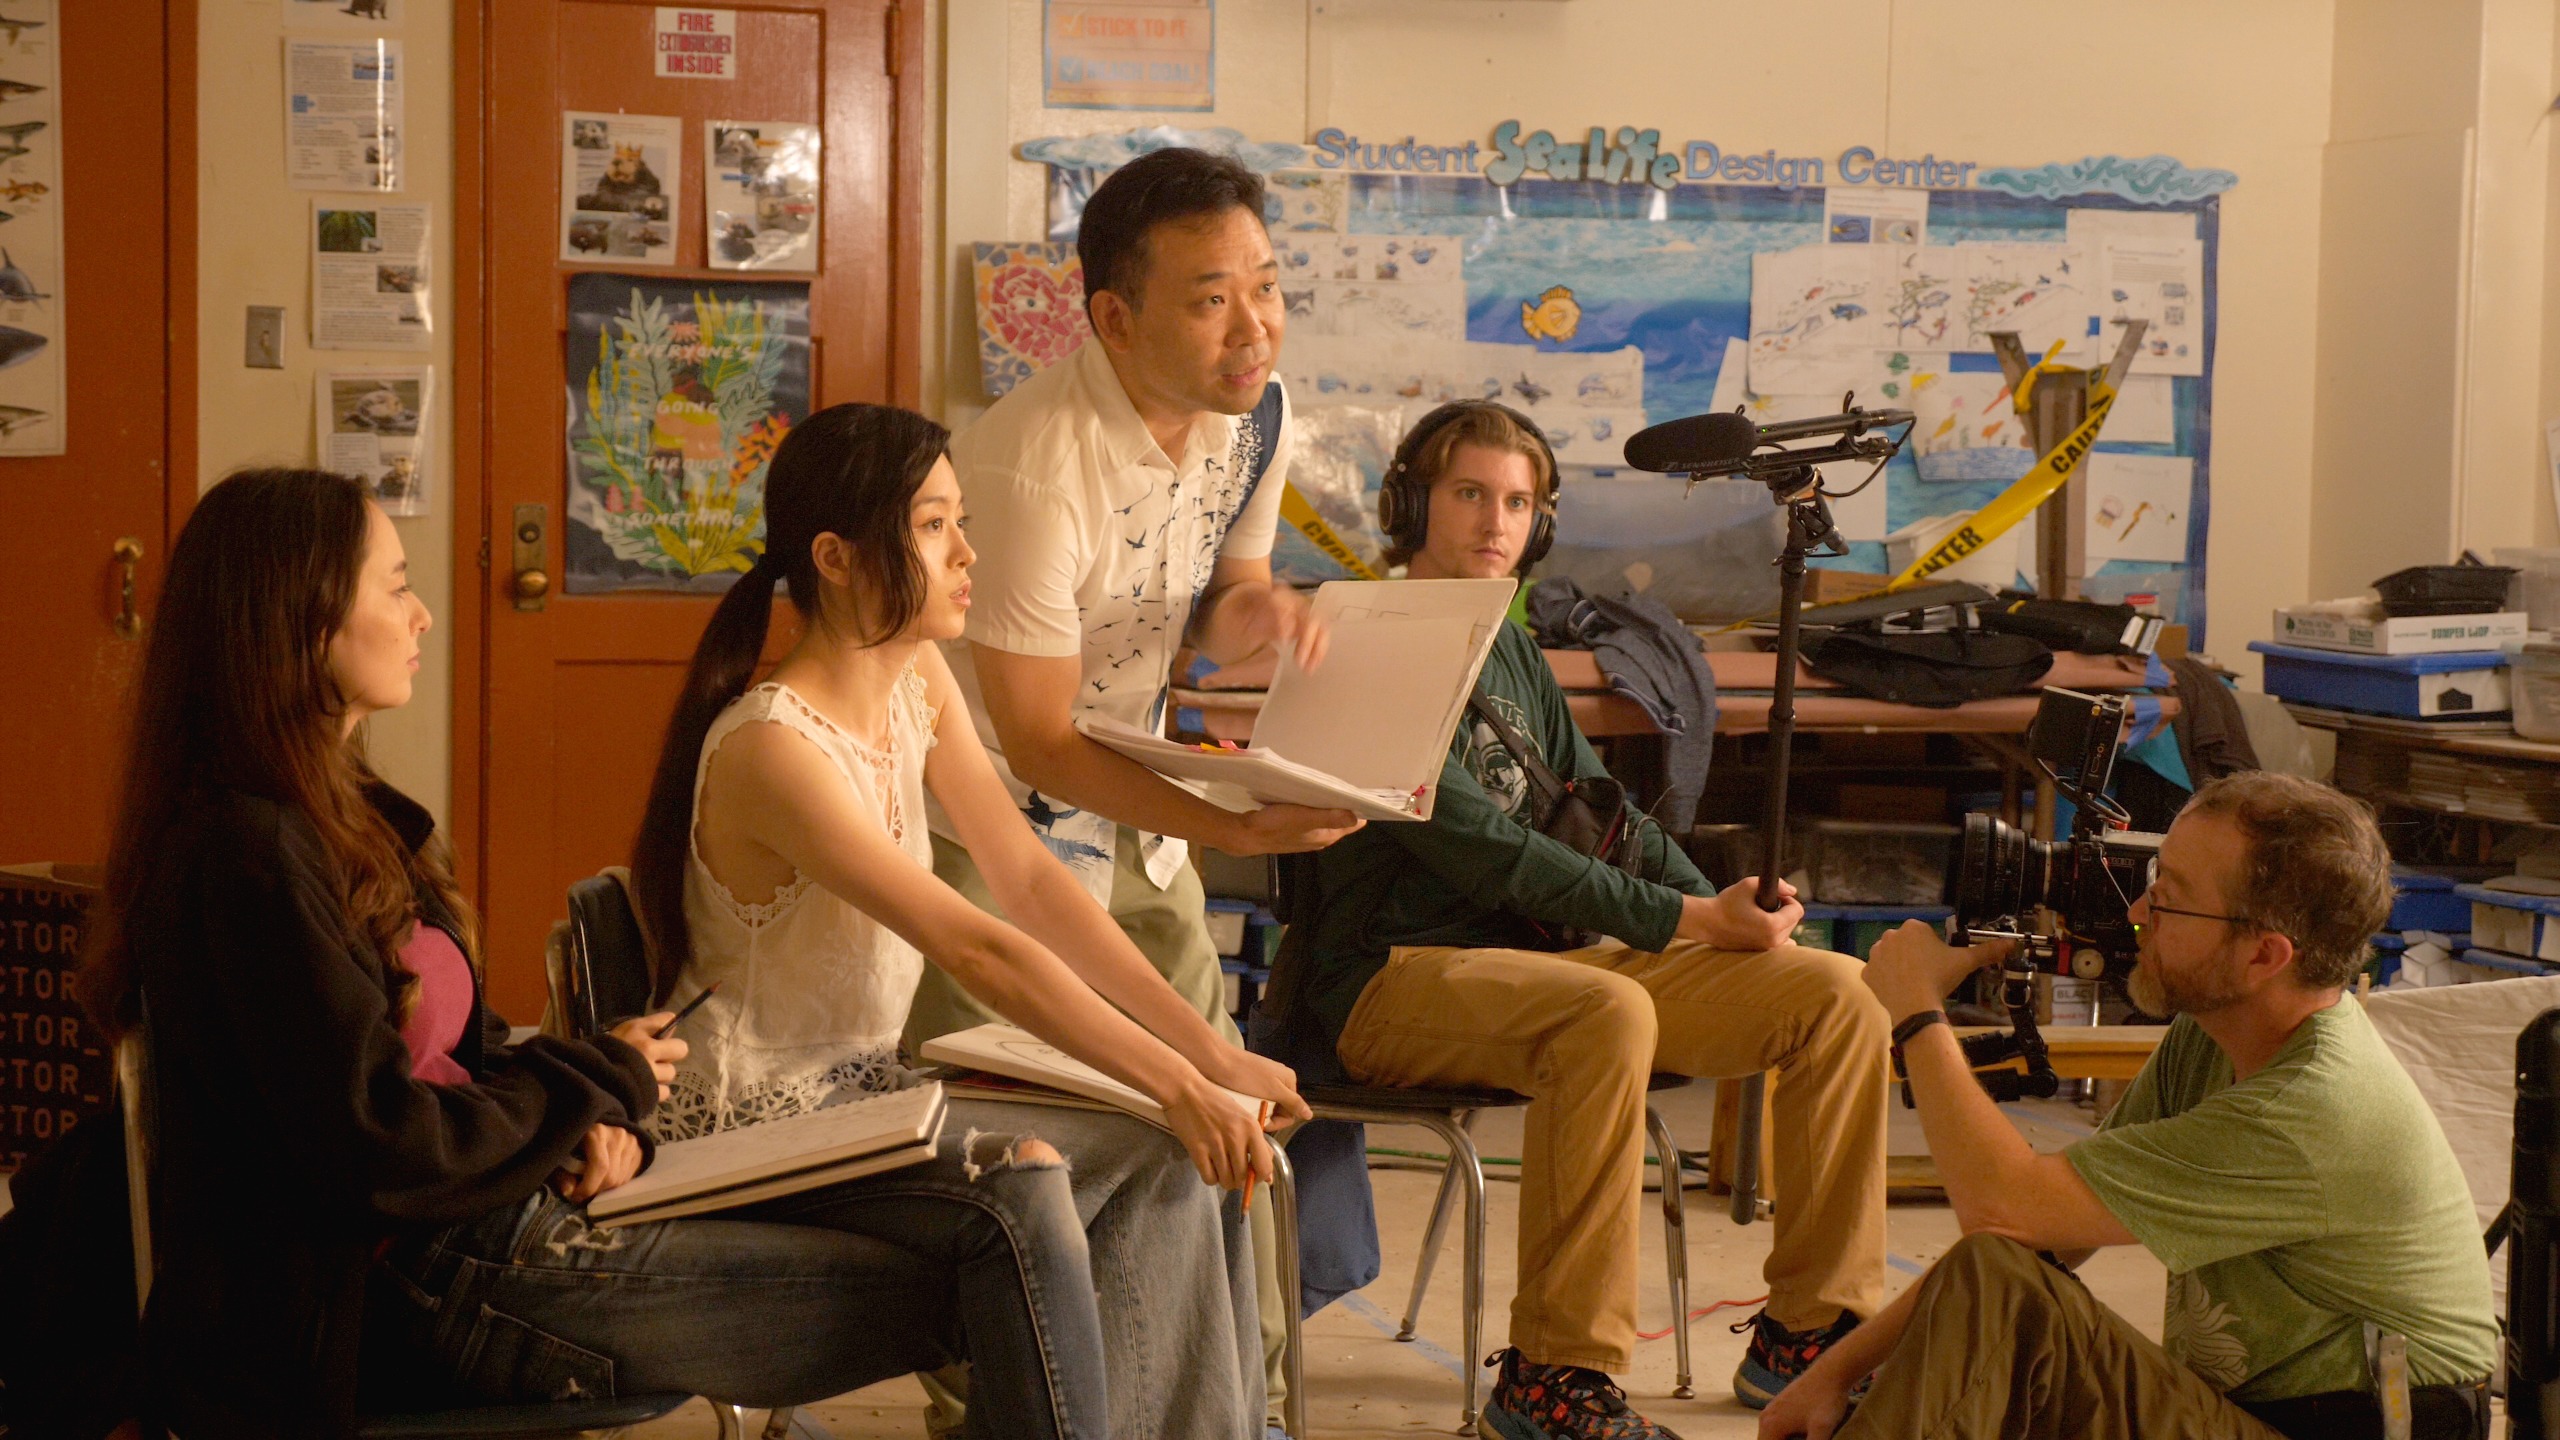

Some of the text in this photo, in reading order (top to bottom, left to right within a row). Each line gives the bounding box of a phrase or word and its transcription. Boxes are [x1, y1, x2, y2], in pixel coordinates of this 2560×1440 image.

[678, 12, 715, 32] FIRE
[1087, 16, 1187, 38] STICK TO IT
[666, 53, 724, 74] INSIDE
[1313, 127, 1479, 172] Student
[1685, 140, 1824, 191] Design
[1839, 145, 1976, 187] Center
[656, 400, 720, 415] GOING
[643, 455, 735, 472] THROUGH
[1681, 457, 1740, 470] SENNHEISER
[629, 510, 746, 528] SOMETHING
